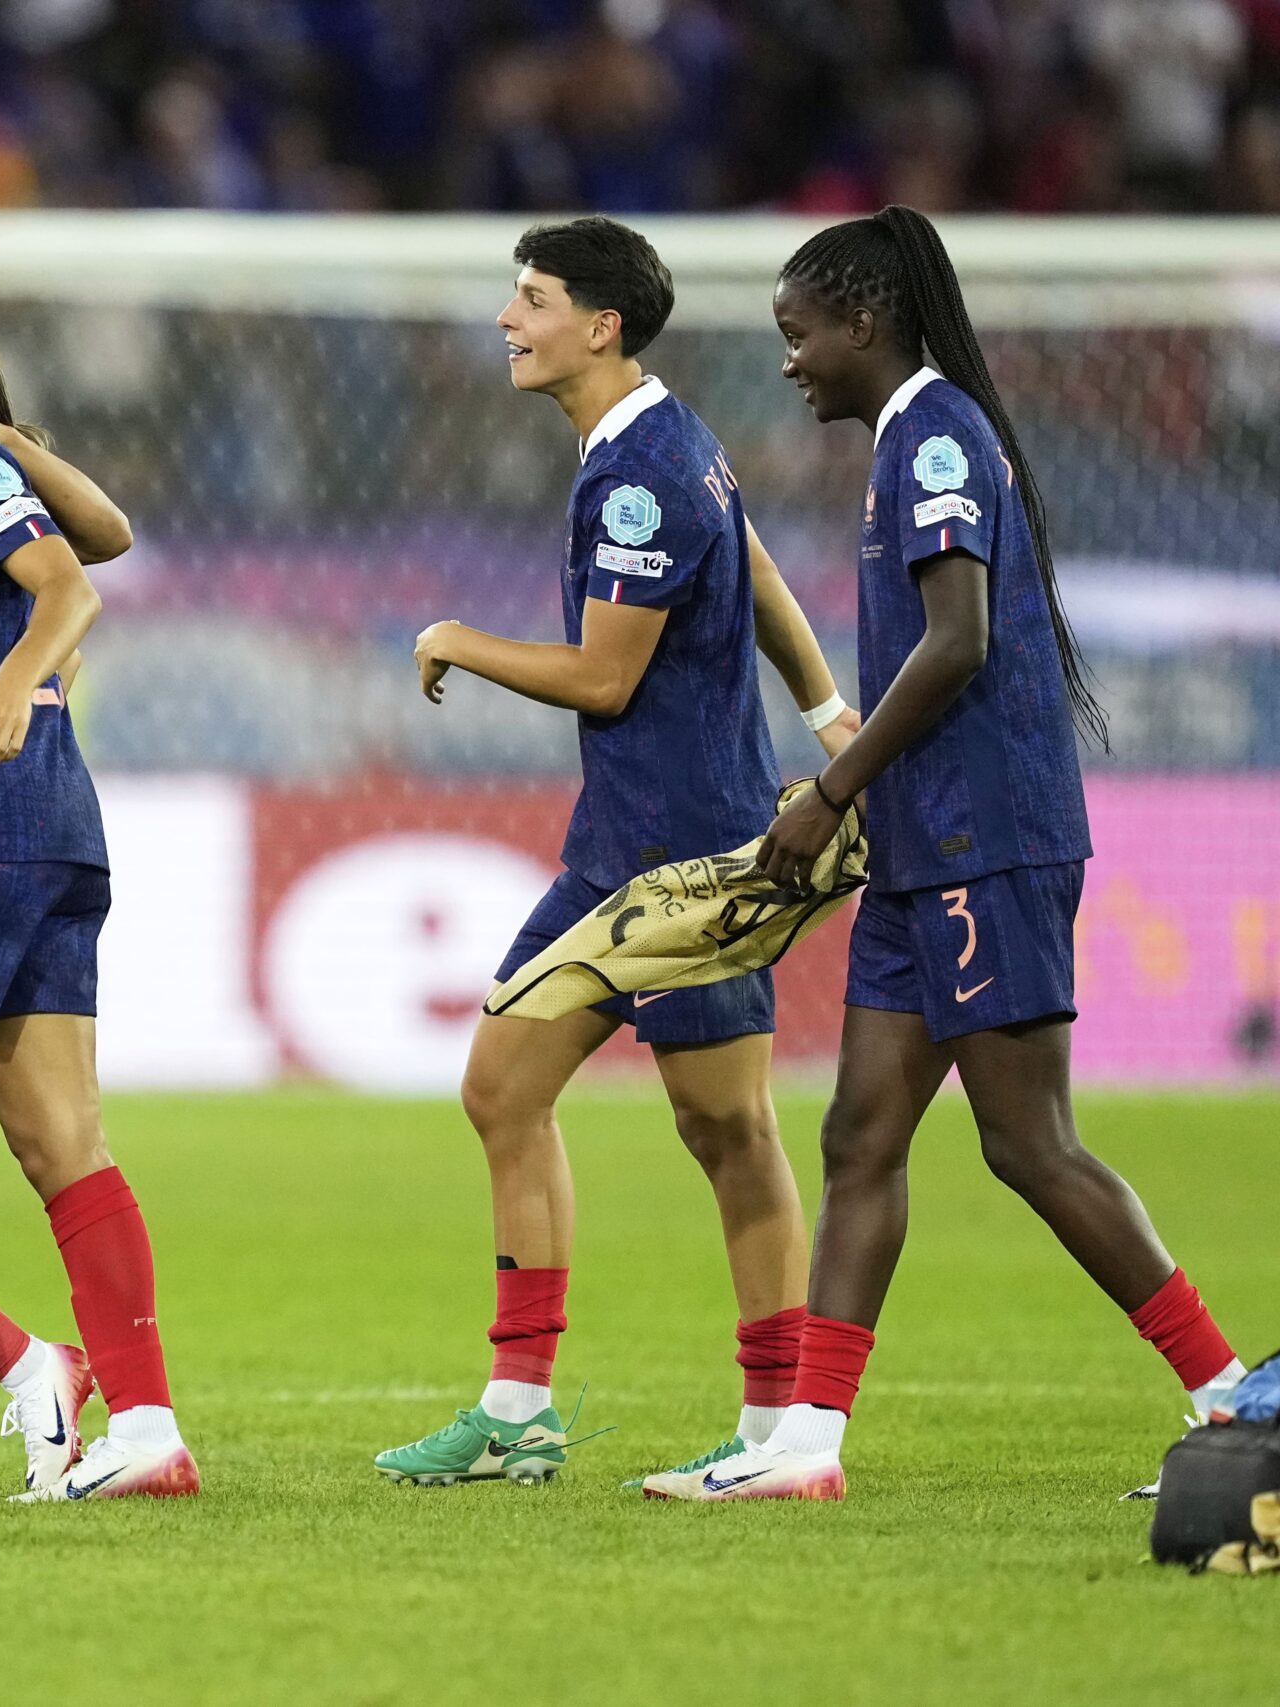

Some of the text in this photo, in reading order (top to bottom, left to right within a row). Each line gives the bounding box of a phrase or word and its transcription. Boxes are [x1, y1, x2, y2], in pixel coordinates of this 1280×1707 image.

[932, 466, 955, 474] Strong
[619, 518, 642, 528] Strong
[642, 557, 661, 570] 10
[941, 887, 977, 971] 3
[133, 1317, 157, 1327] FF
